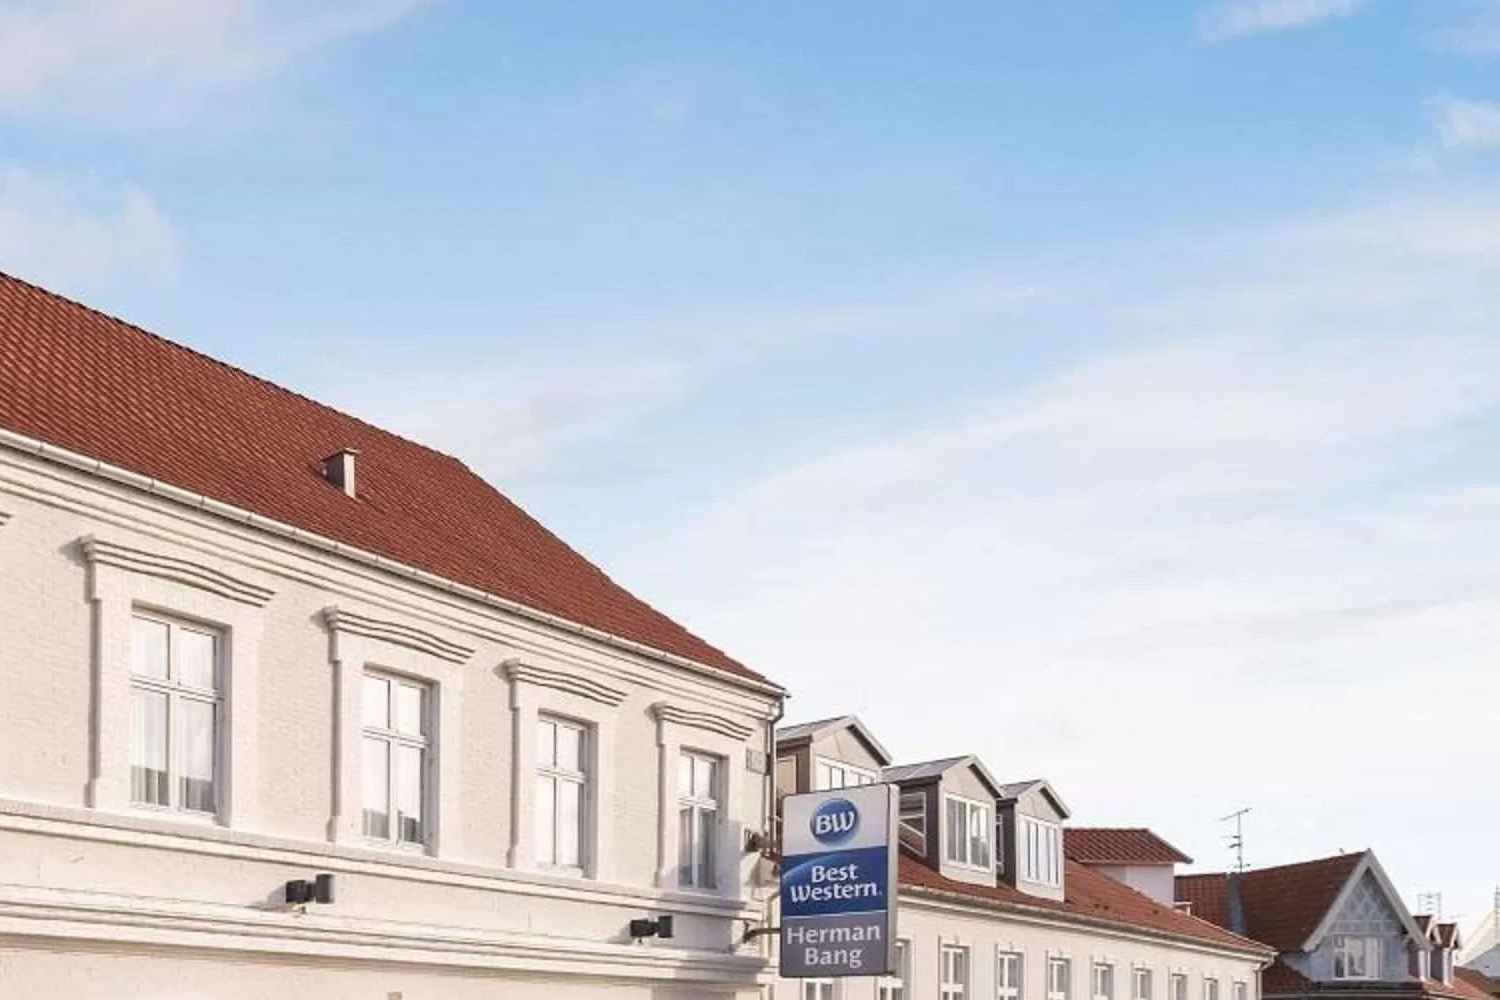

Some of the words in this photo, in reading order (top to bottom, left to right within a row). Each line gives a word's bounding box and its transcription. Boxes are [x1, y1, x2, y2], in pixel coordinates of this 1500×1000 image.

[815, 811, 855, 834] BW
[811, 864, 858, 883] Best
[790, 882, 878, 902] Western
[787, 925, 880, 945] Herman
[804, 948, 863, 968] Bang
